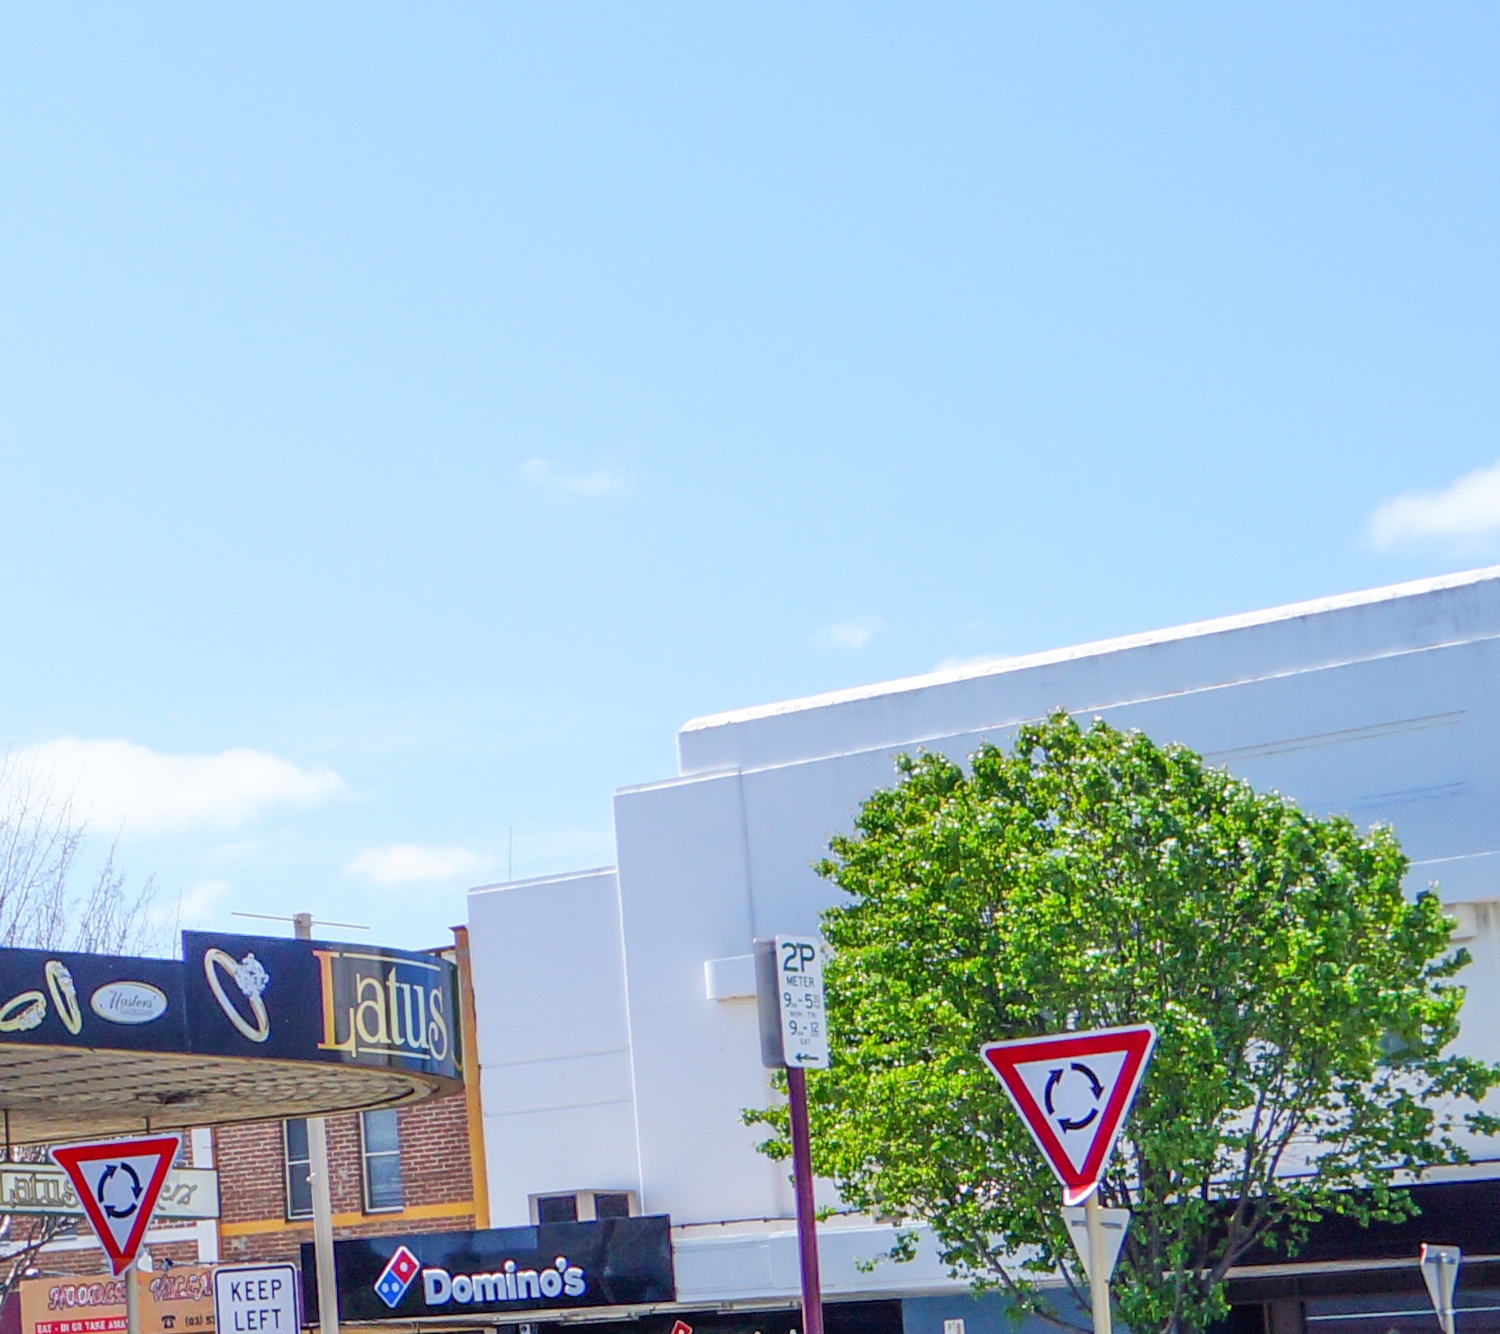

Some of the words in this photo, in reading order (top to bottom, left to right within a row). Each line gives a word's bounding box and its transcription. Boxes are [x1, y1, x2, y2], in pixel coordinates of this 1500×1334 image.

[781, 942, 816, 973] 2P
[786, 975, 816, 988] METER
[313, 950, 450, 1061] Latus
[148, 1271, 214, 1304] VILLA
[229, 1278, 284, 1305] KEEP
[423, 1258, 586, 1307] Domino's
[232, 1308, 283, 1334] LEFT
